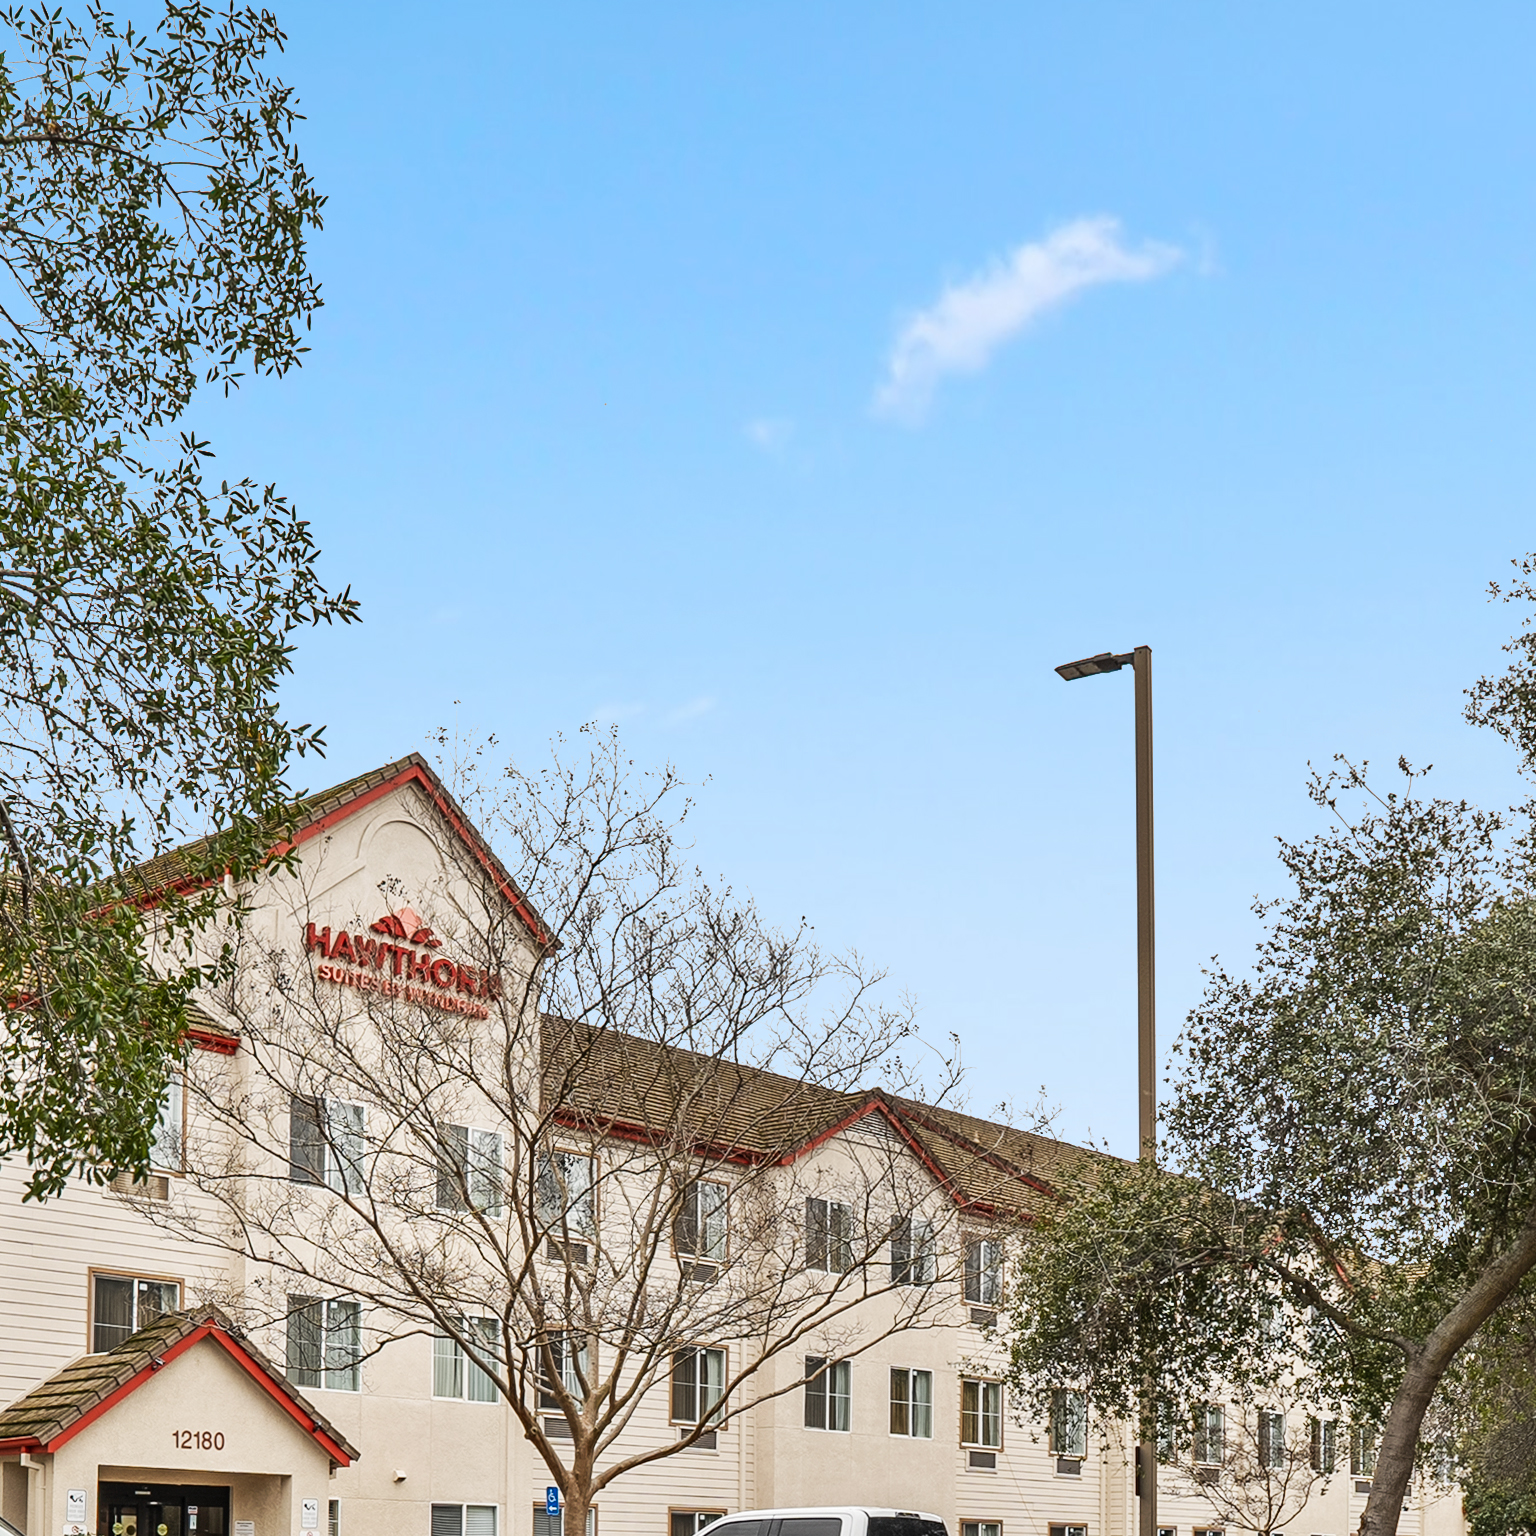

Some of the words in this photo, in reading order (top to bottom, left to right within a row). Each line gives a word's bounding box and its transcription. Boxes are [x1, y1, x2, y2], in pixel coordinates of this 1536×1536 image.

[306, 922, 503, 1000] HAWTHORN
[318, 964, 379, 993] SUITES
[172, 1430, 225, 1450] 12180
